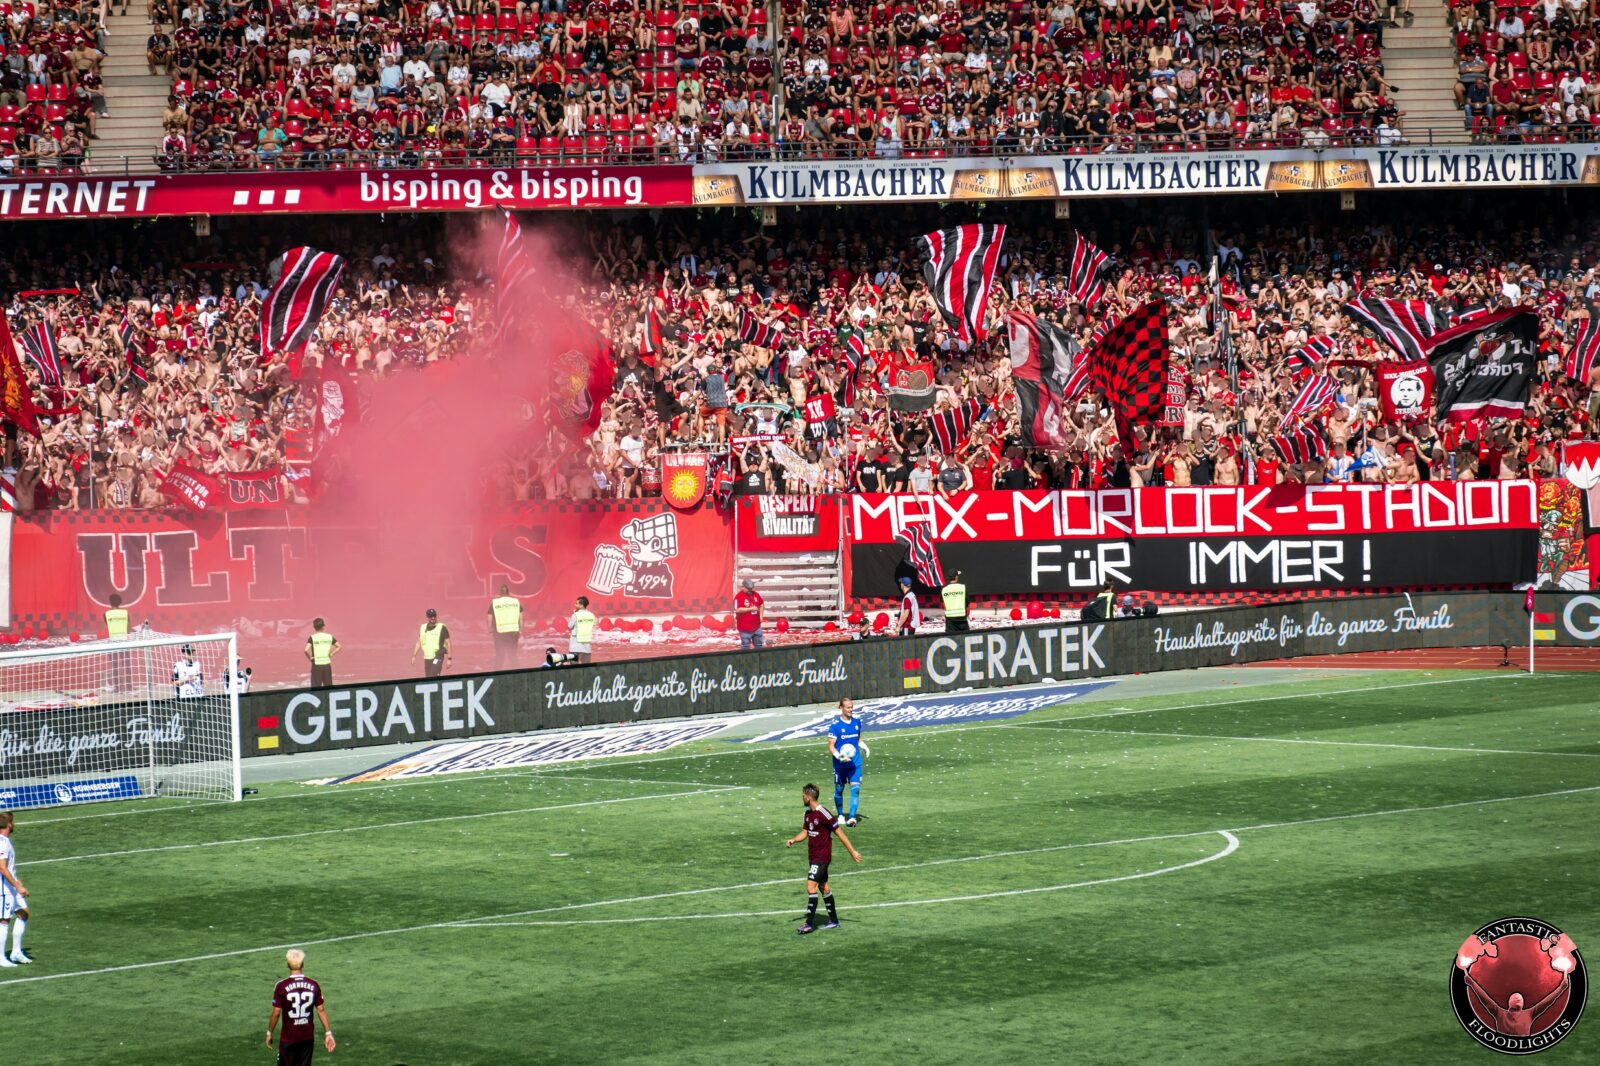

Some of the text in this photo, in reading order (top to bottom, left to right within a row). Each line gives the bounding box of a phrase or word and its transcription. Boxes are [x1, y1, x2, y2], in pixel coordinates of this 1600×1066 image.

[748, 165, 947, 199] KULMBACHER
[1062, 158, 1261, 191] KULMBACHER
[1377, 150, 1578, 184] KULMBACHER
[361, 169, 642, 207] bisping & bisping
[758, 494, 815, 513] RESPEKT
[762, 514, 816, 536] RIVALITÄT
[638, 574, 668, 590] 1994
[1154, 618, 1278, 656] Haushaltsgeräte
[1280, 615, 1305, 647] für
[1306, 611, 1336, 638] die
[1338, 616, 1388, 647] ganze
[926, 624, 1106, 685] GERATEK
[545, 671, 688, 712] Haushaltsgeräte
[689, 668, 718, 702] für
[720, 664, 747, 692] die
[748, 670, 793, 701] ganze
[284, 678, 496, 745] GERATEK
[34, 724, 65, 753] die
[68, 731, 120, 764] ganze
[286, 991, 314, 1019] 32
